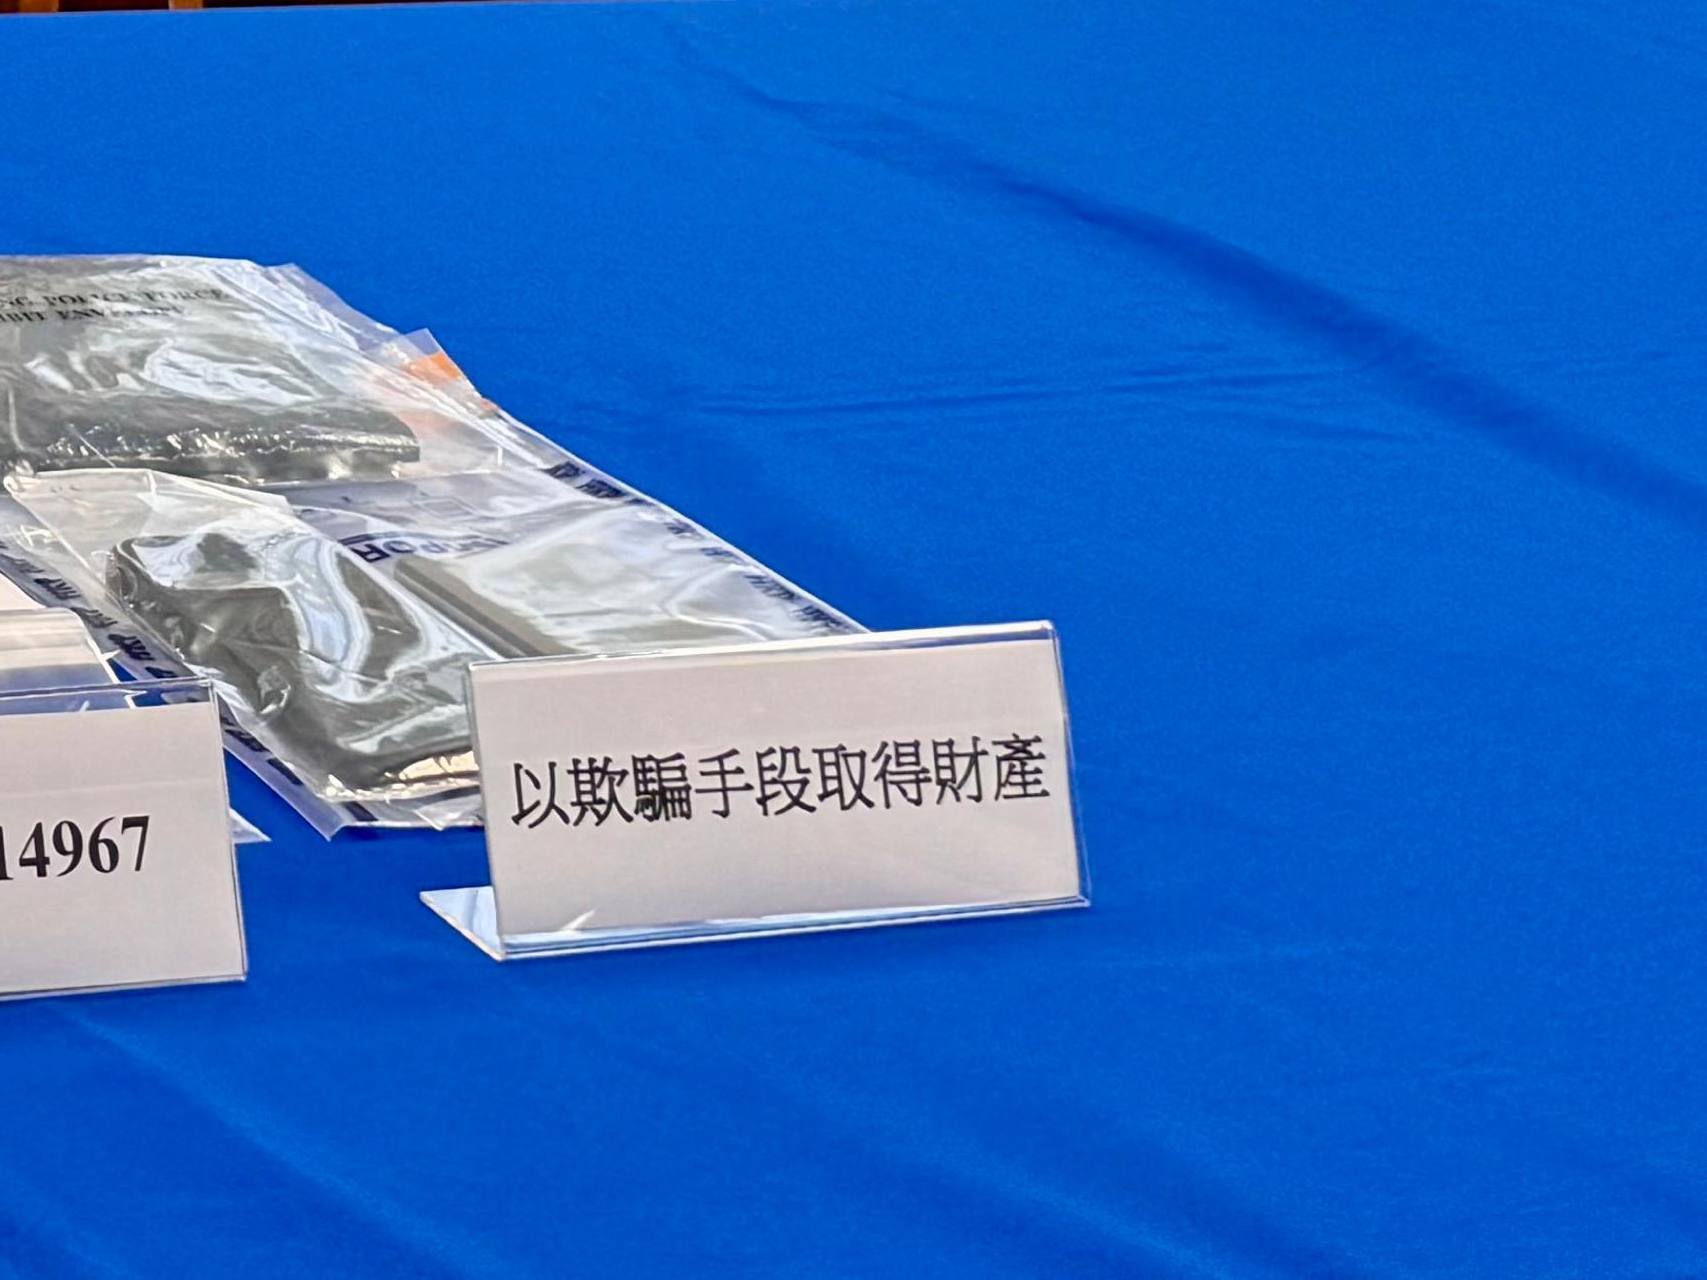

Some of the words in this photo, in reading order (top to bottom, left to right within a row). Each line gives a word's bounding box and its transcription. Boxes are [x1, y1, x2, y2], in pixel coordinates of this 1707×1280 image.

[510, 733, 1051, 829] 以欺騙手段取得財產
